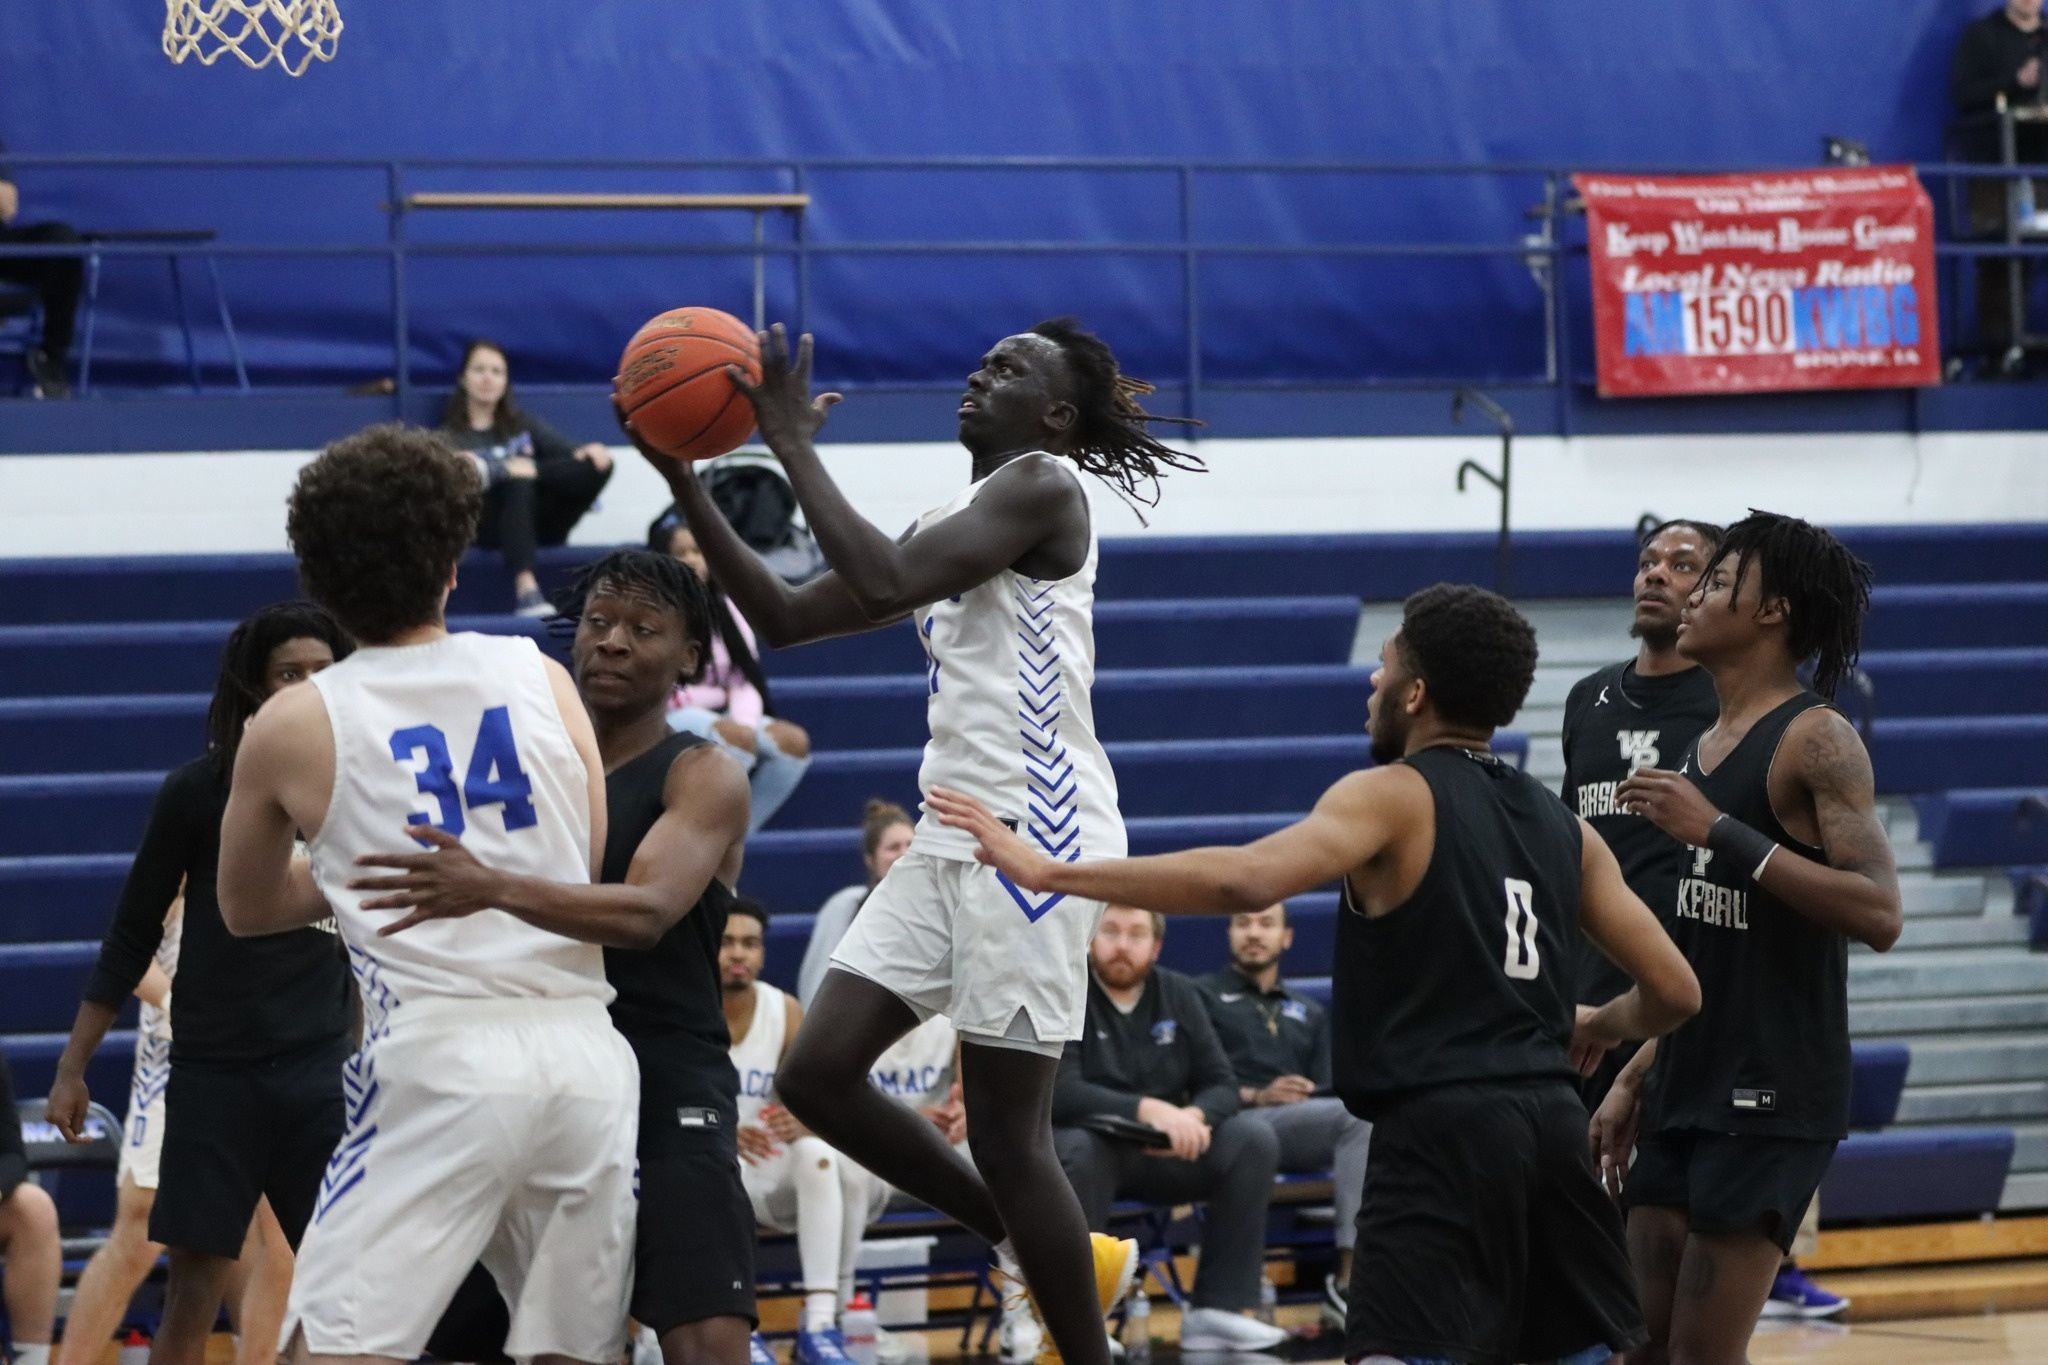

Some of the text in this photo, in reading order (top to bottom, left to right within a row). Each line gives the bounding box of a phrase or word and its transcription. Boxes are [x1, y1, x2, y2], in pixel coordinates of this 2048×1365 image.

[1620, 264, 1714, 296] Local
[1815, 257, 1916, 287] Radio
[1687, 292, 1789, 350] 1590
[1793, 283, 1920, 349] KWBG
[388, 705, 538, 850] 34
[1503, 876, 1540, 980] 0
[707, 1112, 718, 1124] XL
[1761, 1095, 1771, 1105] M
